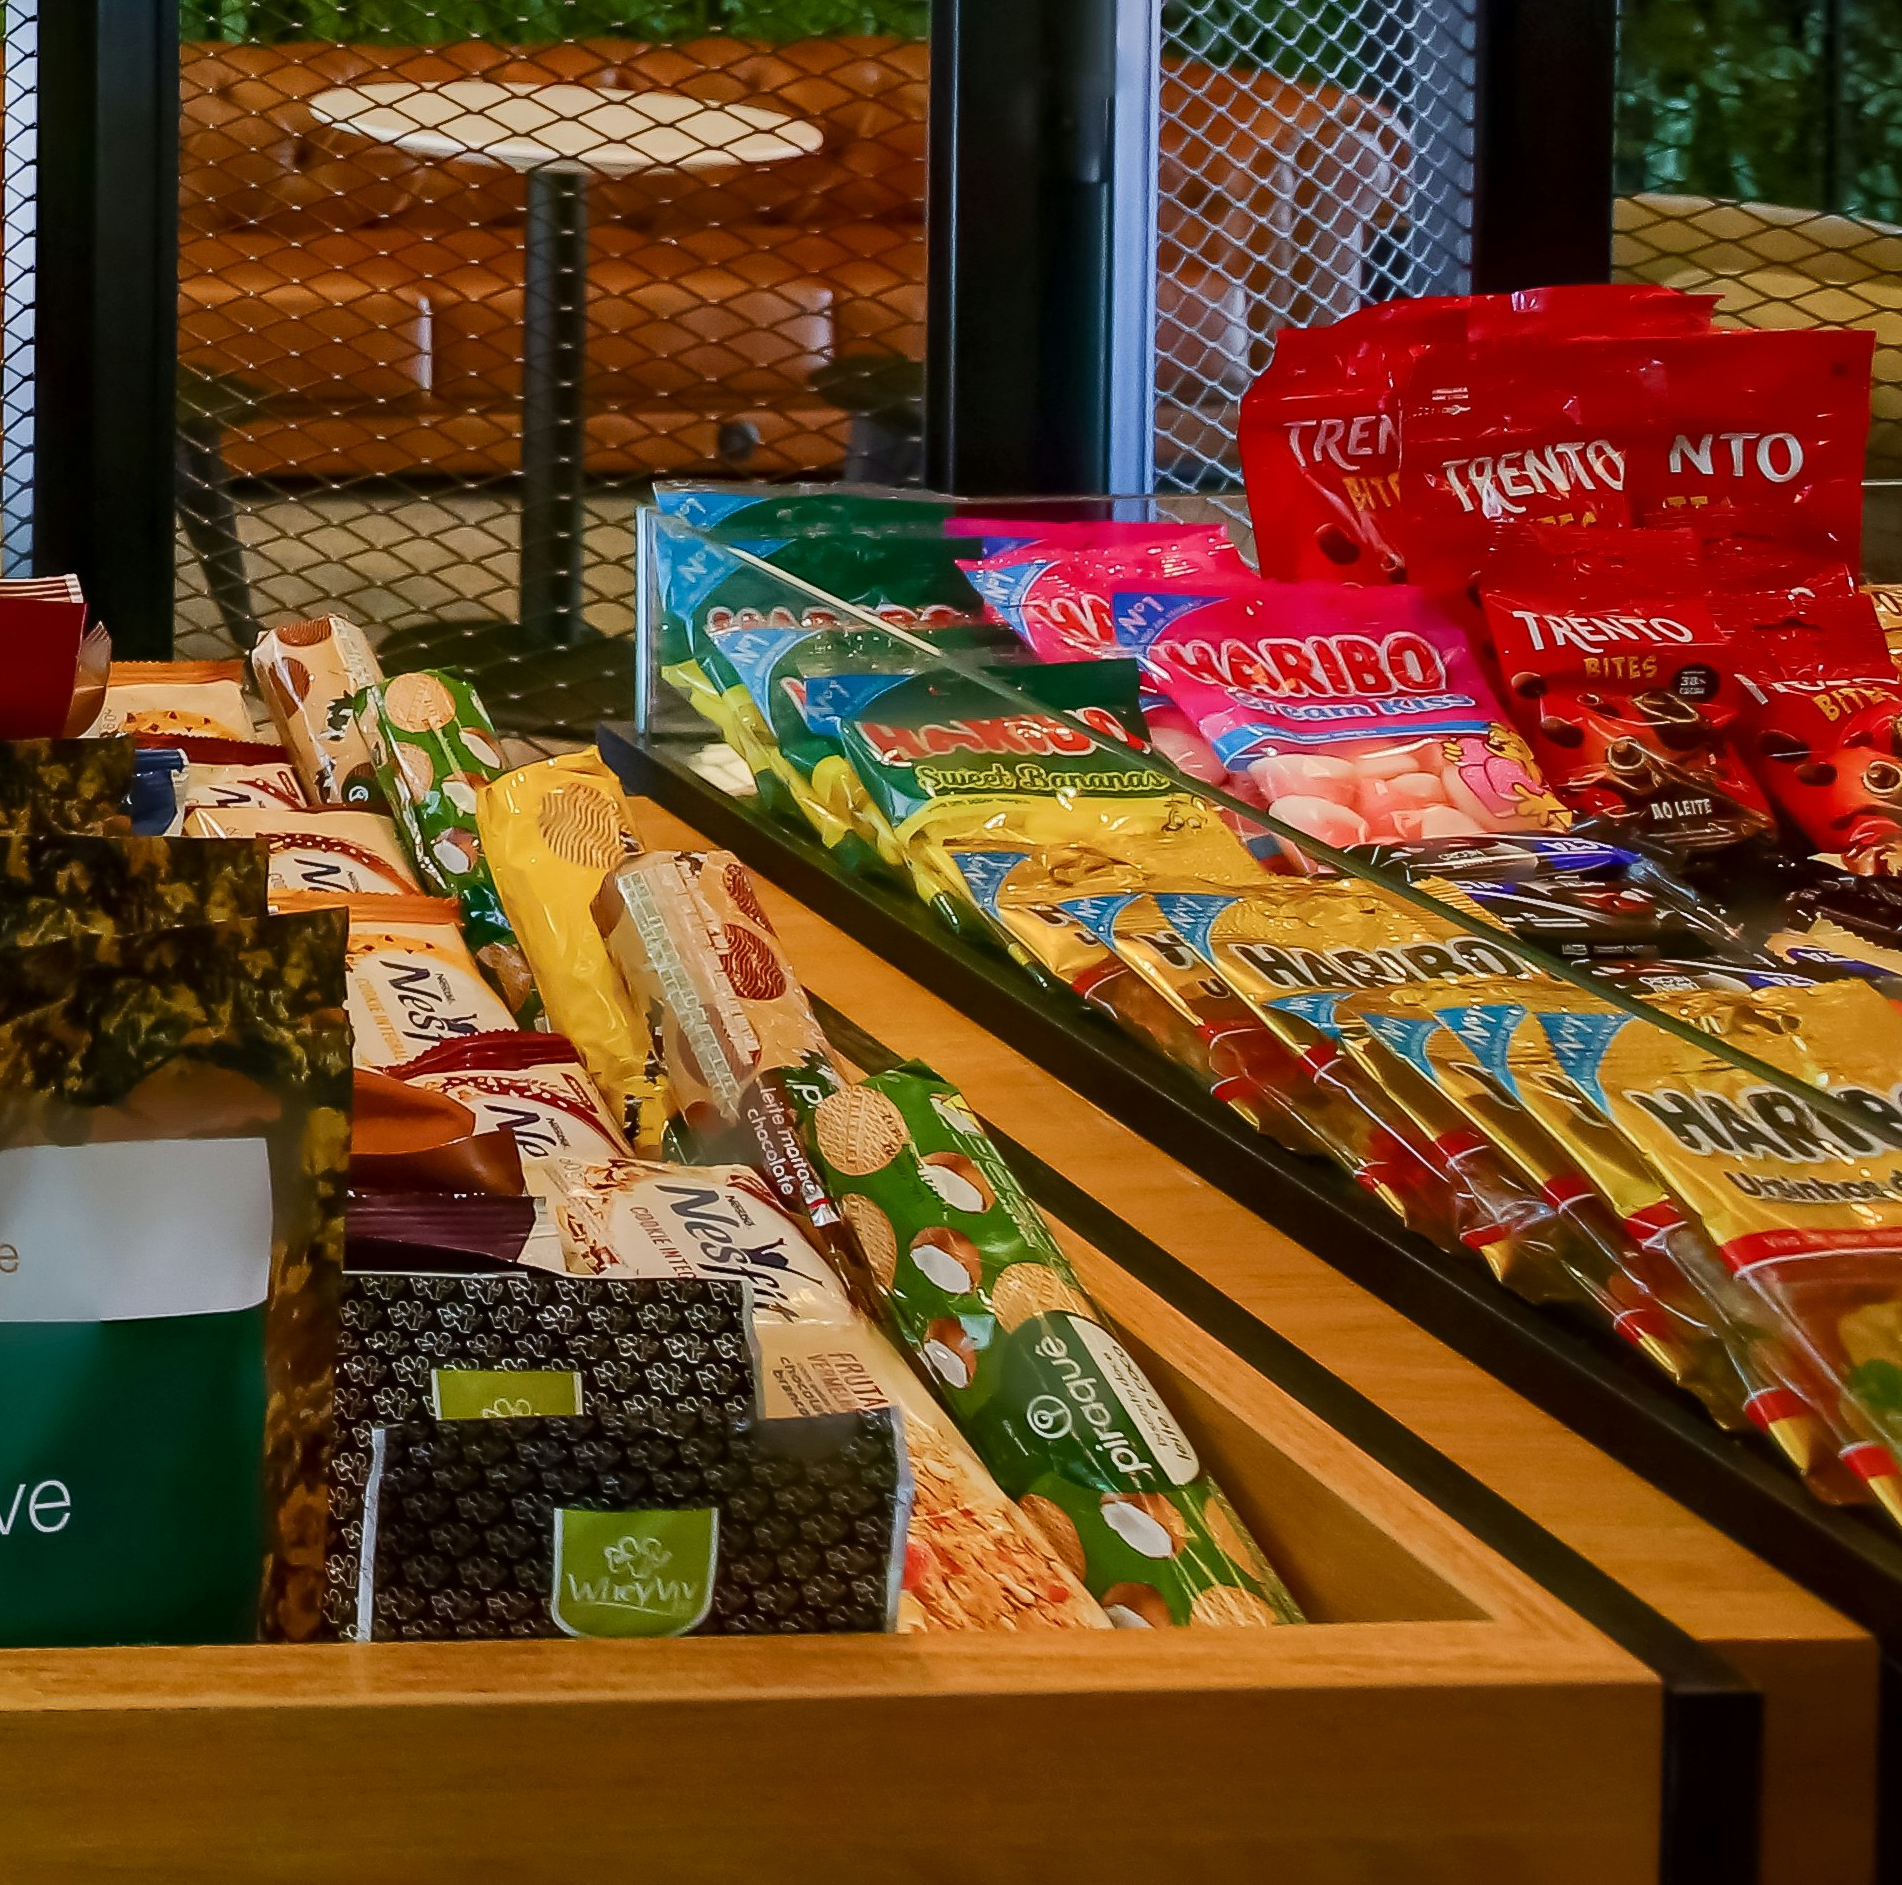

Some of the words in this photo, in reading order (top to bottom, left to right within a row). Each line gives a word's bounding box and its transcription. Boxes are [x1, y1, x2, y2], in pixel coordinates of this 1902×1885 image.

[1284, 413, 1401, 472] TREN
[1669, 432, 1805, 484] NTO
[1442, 438, 1627, 514] TRENTO
[1512, 610, 1694, 654] TRENTO
[1147, 630, 1446, 698] HARIBO
[1583, 654, 1659, 681] BITES
[914, 763, 1016, 792] Sweet
[1015, 762, 1172, 792] Bananas
[1674, 797, 1713, 818] LEITE
[760, 1086, 786, 1126] leite
[747, 1107, 795, 1196] chocolate
[629, 1205, 673, 1247] COOKIE
[827, 1351, 890, 1409] FRUTA
